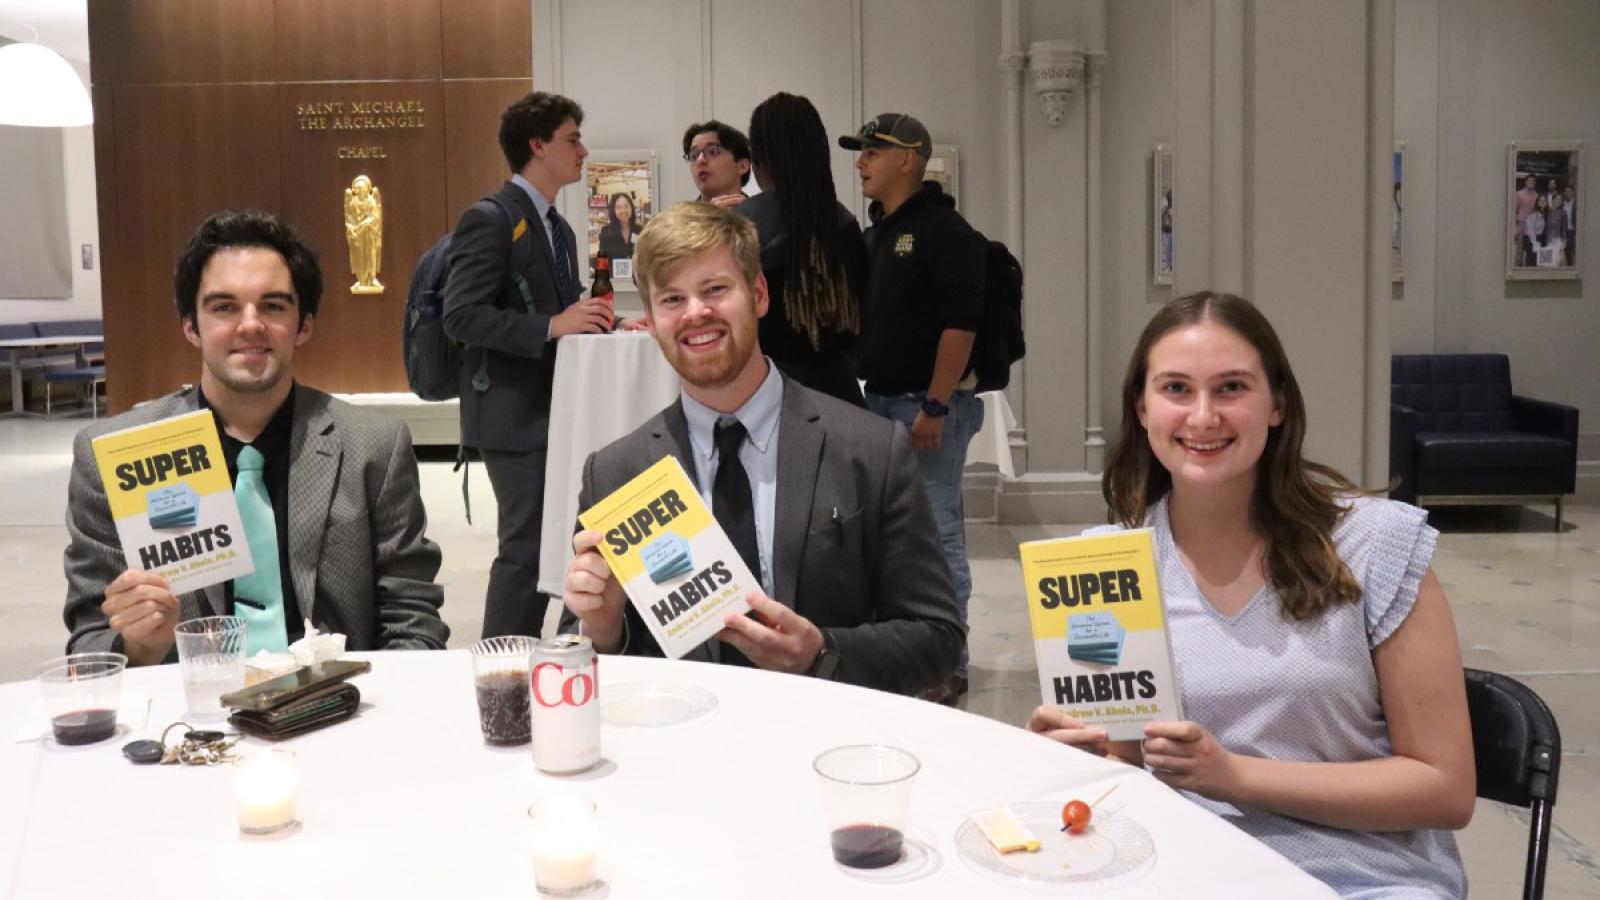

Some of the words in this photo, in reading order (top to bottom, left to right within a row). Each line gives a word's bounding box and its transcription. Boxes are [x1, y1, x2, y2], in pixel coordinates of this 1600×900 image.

[297, 102, 343, 115] SAINT
[351, 101, 424, 113] MICHAEL
[299, 118, 327, 130] THE
[334, 117, 424, 129] ARCHANGEL
[337, 146, 387, 159] CHAPEL
[116, 445, 212, 491] SUPER
[605, 490, 688, 555] SUPER
[138, 524, 233, 571] HABITS
[650, 560, 732, 627] HABITS
[1039, 569, 1142, 609] SUPER
[1053, 670, 1156, 705] HABITS
